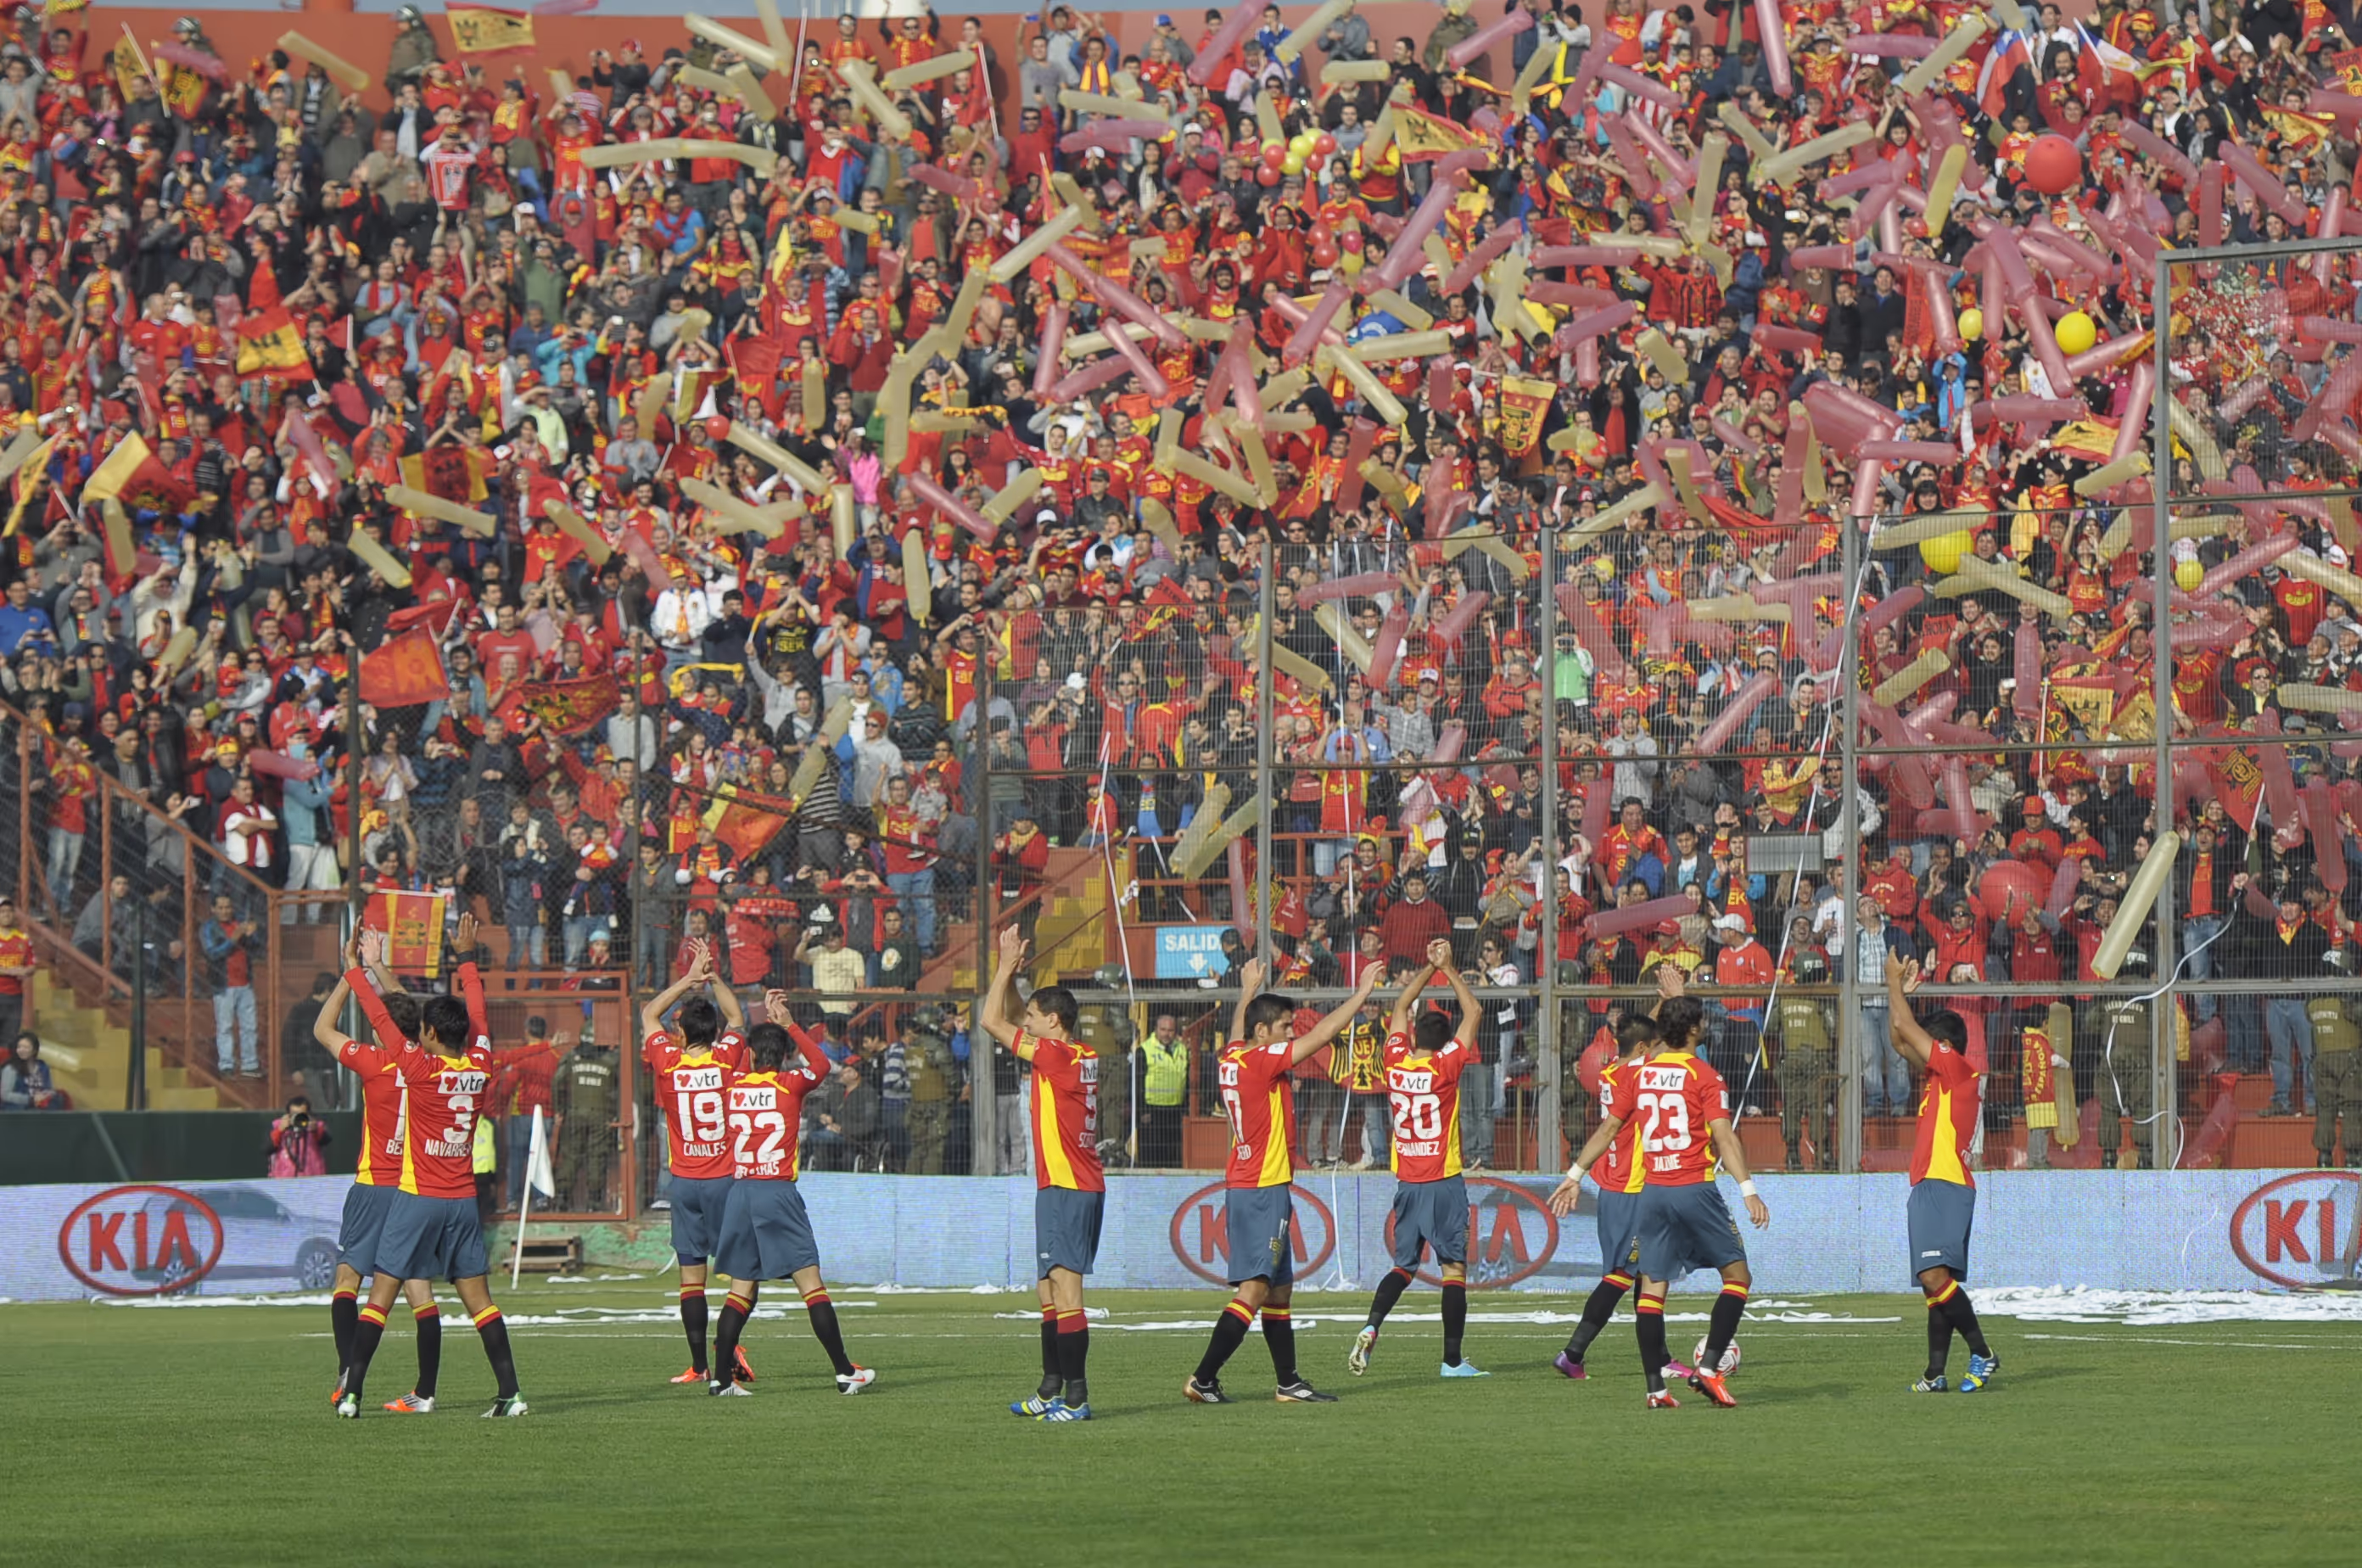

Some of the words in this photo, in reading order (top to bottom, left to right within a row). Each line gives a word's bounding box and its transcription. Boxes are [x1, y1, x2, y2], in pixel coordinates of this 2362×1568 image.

[1165, 933, 1223, 952] SALID
[443, 1095, 474, 1144] 3
[677, 1091, 725, 1142] 19
[729, 1112, 786, 1164] 22
[1390, 1092, 1442, 1140] 20
[1637, 1092, 1693, 1152] 23
[683, 1141, 727, 1157] CANALES
[1652, 1153, 1682, 1173] JAIME
[87, 1210, 196, 1272] KIA
[1199, 1205, 1308, 1263] KA
[1420, 1203, 1530, 1263] IA
[2264, 1199, 2362, 1263] KI
